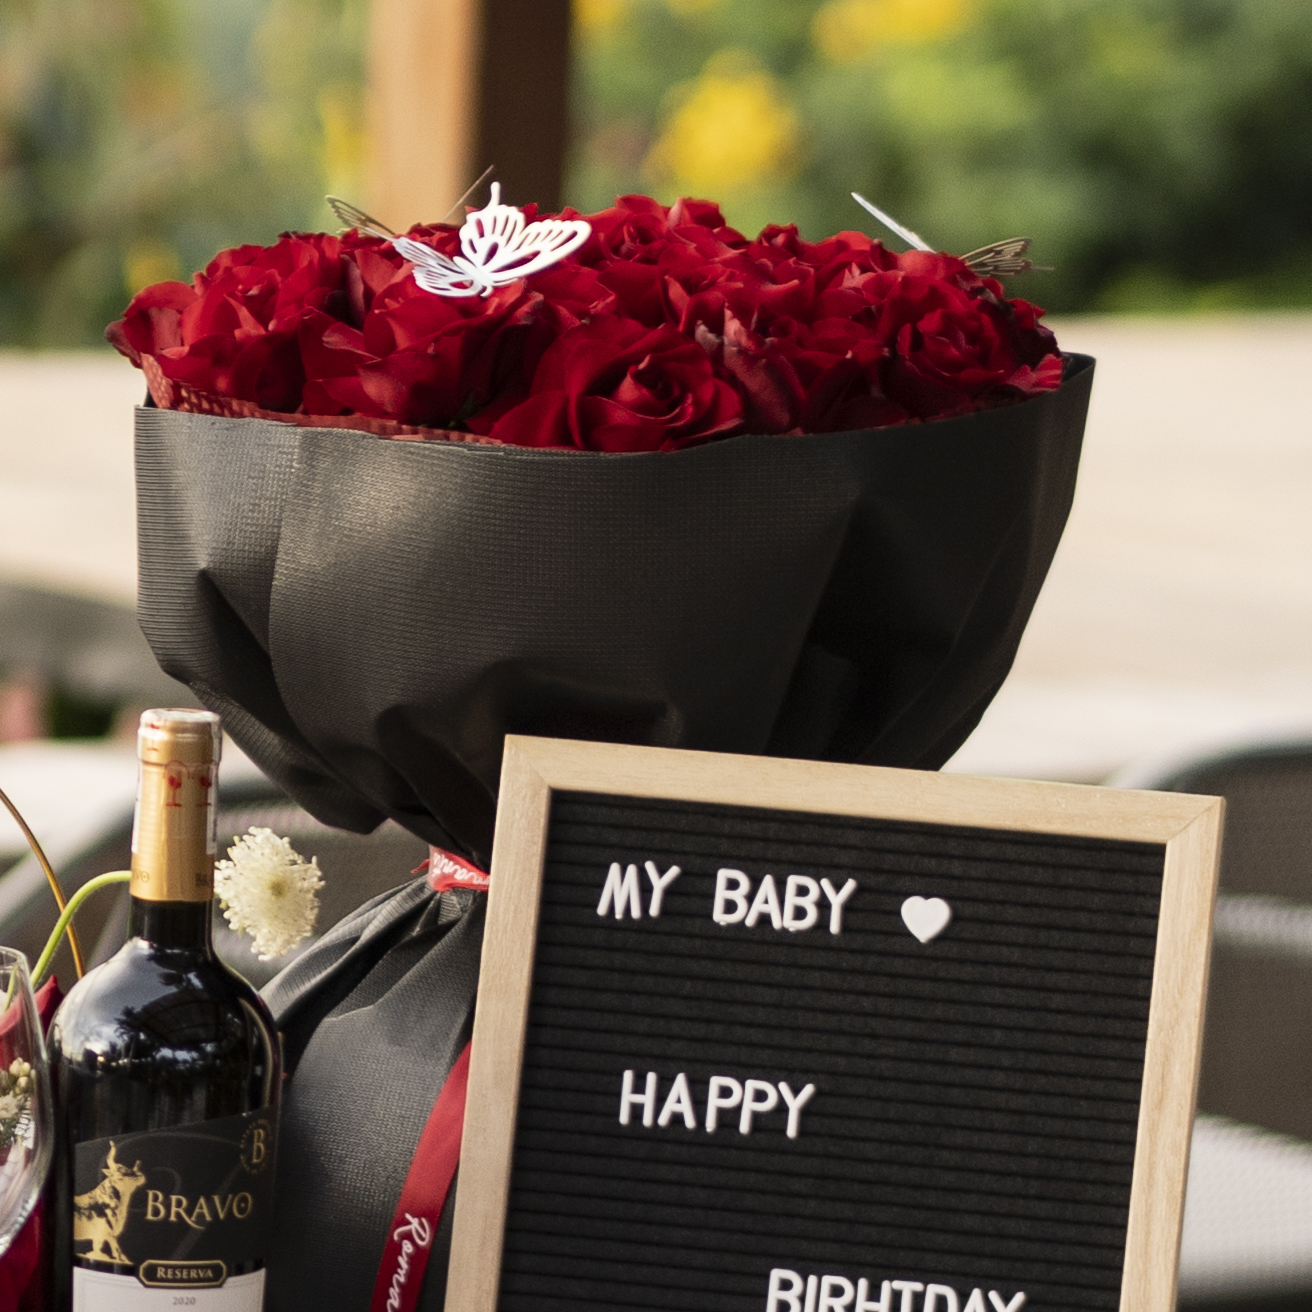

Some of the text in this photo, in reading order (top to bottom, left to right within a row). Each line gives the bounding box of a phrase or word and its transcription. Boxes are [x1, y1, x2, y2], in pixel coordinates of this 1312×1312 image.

[596, 860, 857, 935] MY BABY
[618, 1069, 816, 1139] HAPPY
[145, 1188, 253, 1230] BRAVO
[156, 1265, 214, 1280] RESERVA
